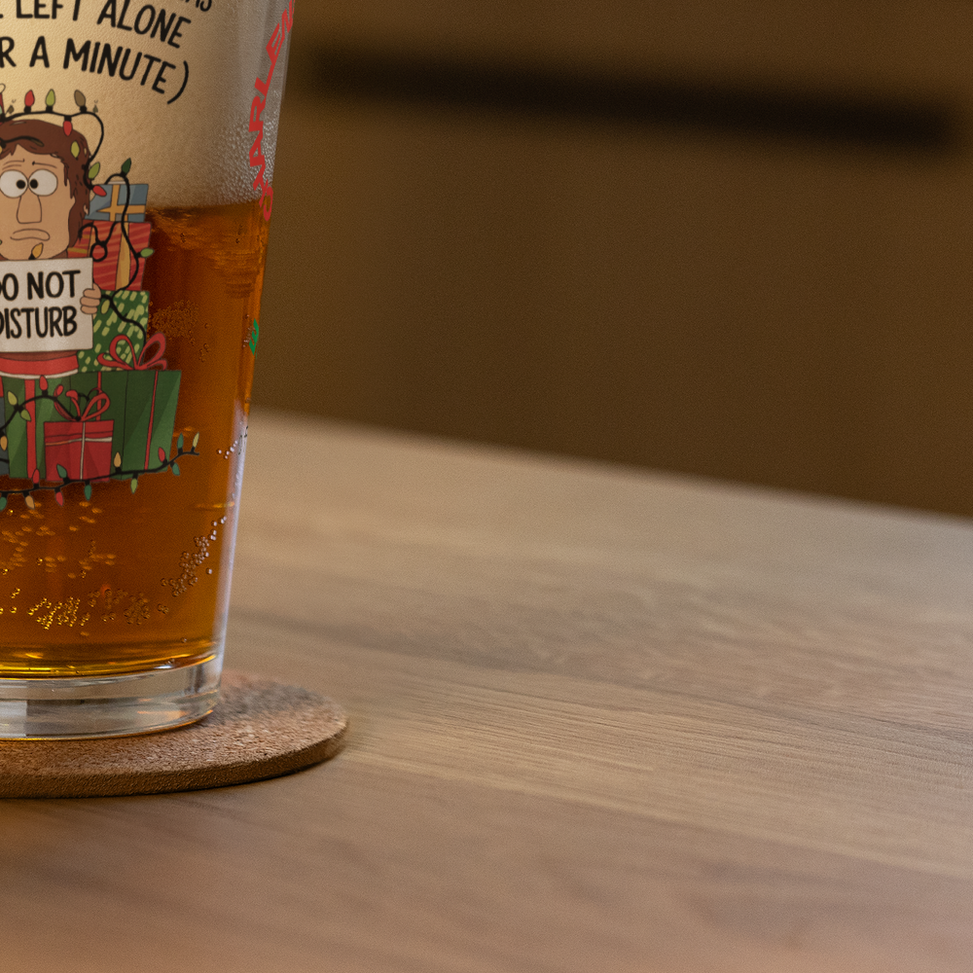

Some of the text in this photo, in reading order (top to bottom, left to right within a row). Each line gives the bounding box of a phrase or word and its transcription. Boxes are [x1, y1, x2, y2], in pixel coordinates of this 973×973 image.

[29, 36, 50, 69] A
[63, 38, 190, 106] MINUTE)
[26, 269, 81, 300] NOT
